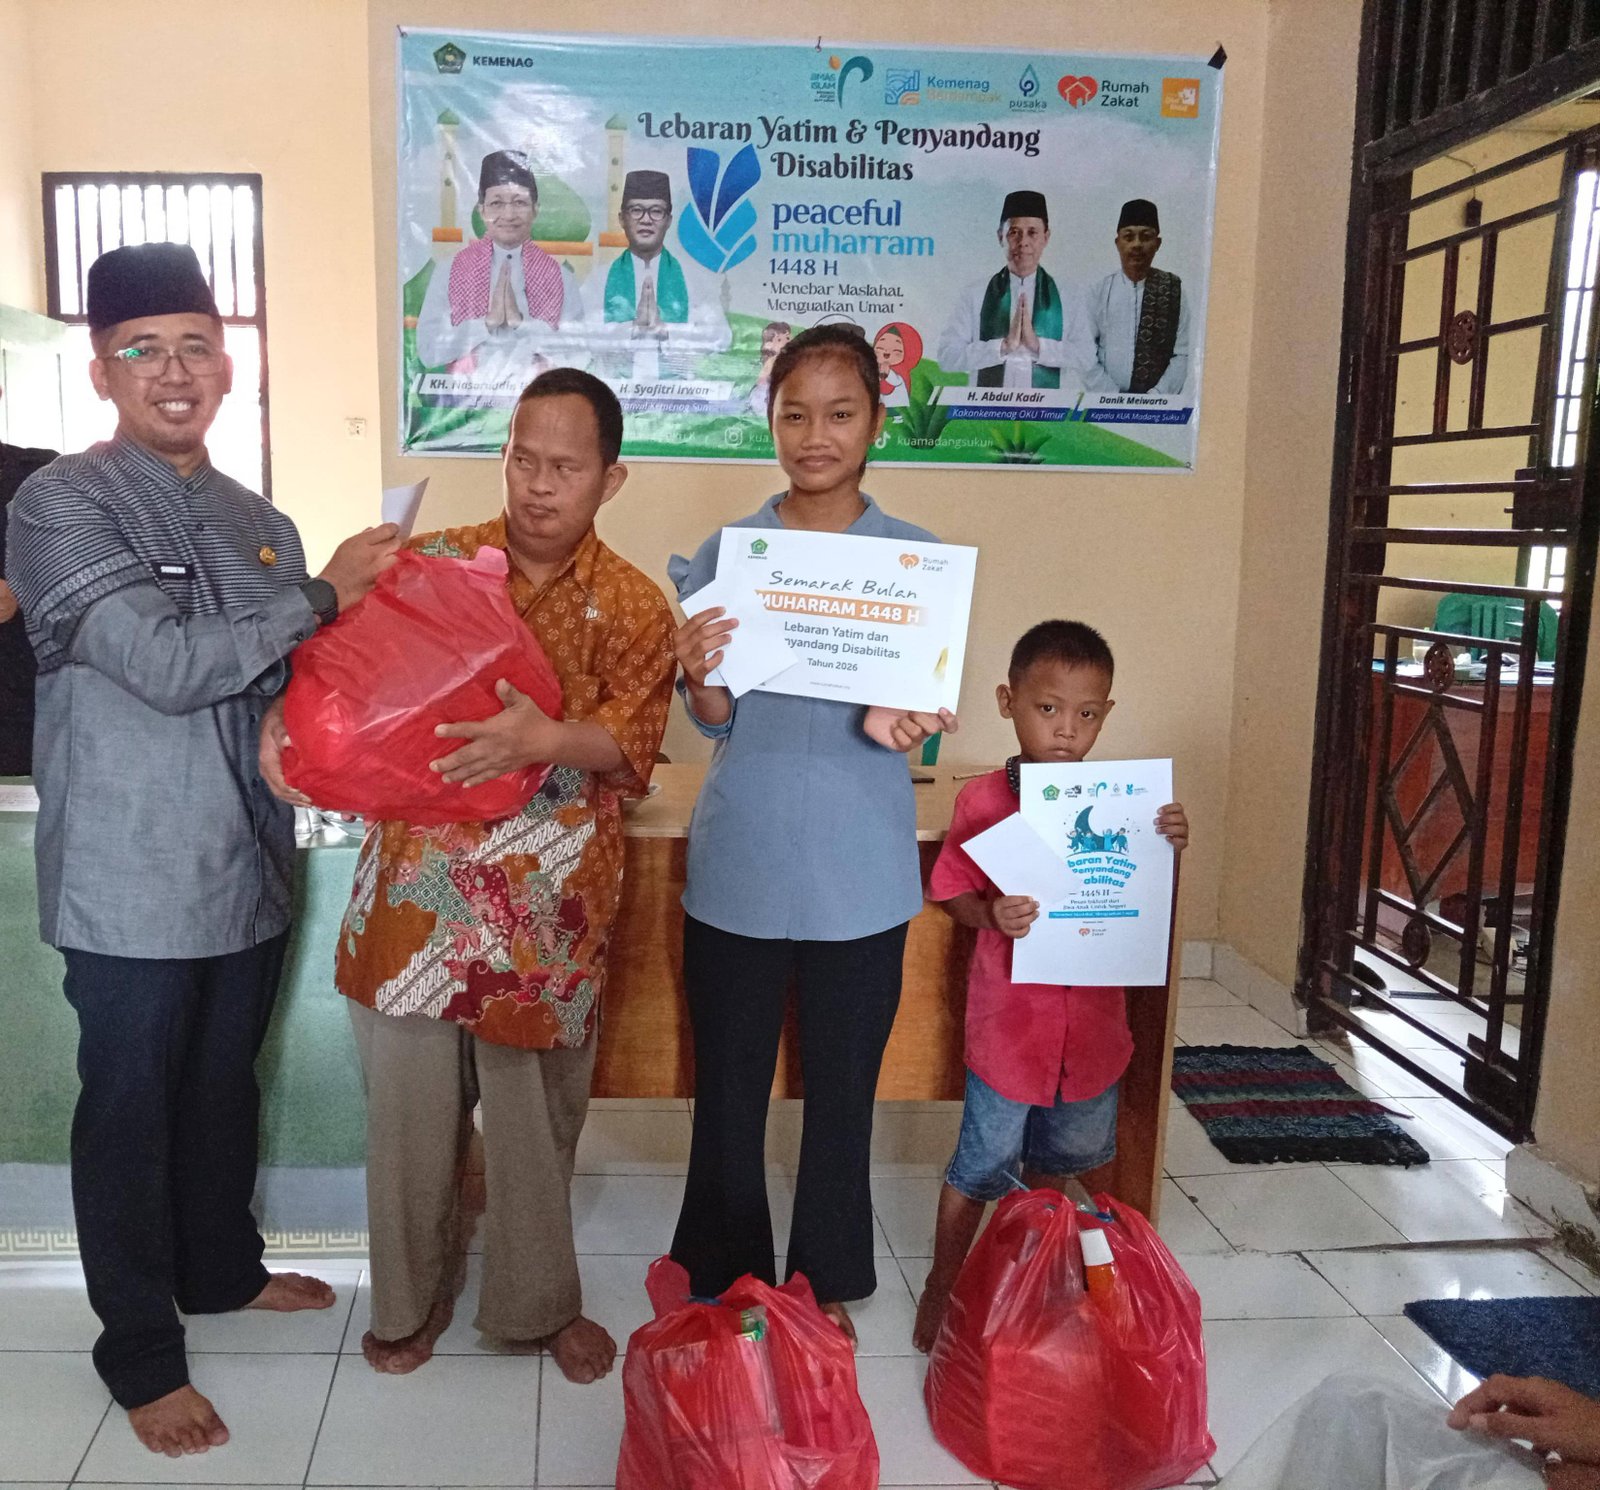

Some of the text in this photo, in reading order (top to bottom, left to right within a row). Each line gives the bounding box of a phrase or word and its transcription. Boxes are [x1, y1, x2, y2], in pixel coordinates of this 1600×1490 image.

[472, 55, 534, 68] KEMENAG
[927, 76, 990, 92] Kemenag
[1101, 80, 1149, 93] Rumah
[1009, 99, 1047, 109] pusaka
[1101, 94, 1139, 107] Zakat
[637, 112, 1041, 157] Lebaran Yatim & Penyandang
[770, 151, 914, 180] Disabilitas
[772, 198, 902, 230] peaceful
[772, 227, 935, 256] muharram
[769, 258, 839, 276] 1448 H
[770, 282, 834, 296] Menebar
[767, 298, 895, 314] Menguatkan Umat
[429, 379, 448, 390] KH.
[967, 391, 1045, 403] H. Abdul Kadir
[1099, 396, 1168, 406] Danik Meiwarto
[1019, 409, 1038, 418] OKU
[1040, 410, 1065, 419] Timur
[1116, 412, 1130, 420] KUA
[768, 570, 918, 599] Semarak Bulan
[758, 592, 920, 623] MUHARRAM 1448 H
[784, 621, 889, 642] Lebaran Yatim dan
[842, 642, 901, 659] Disabilitas
[807, 657, 858, 672] Tahun 2026
[1105, 855, 1137, 872] Yatim
